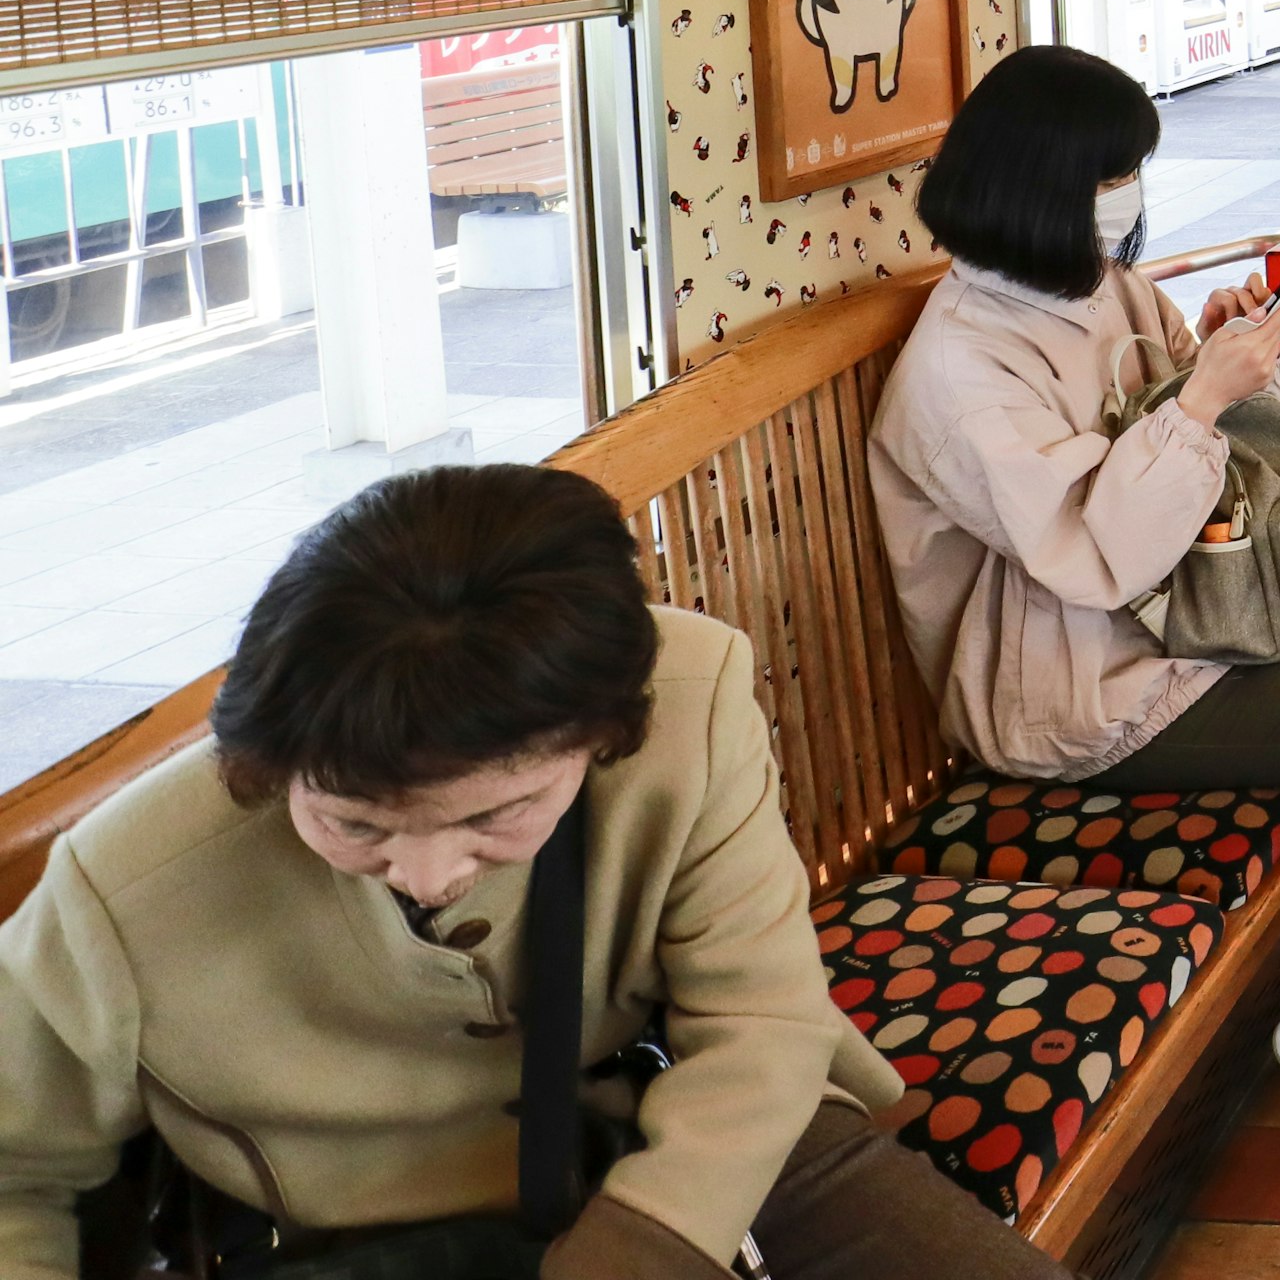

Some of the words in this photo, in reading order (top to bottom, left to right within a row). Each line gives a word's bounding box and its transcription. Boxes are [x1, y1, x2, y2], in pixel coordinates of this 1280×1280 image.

[1187, 28, 1231, 64] KIRIN
[145, 96, 191, 118] 86.1
[9, 116, 62, 139] 96.3
[852, 139, 874, 153] SUPER
[873, 133, 901, 147] STATION
[901, 126, 927, 140] MASTER
[1131, 912, 1145, 923] TA
[1123, 936, 1146, 948] MA
[841, 954, 872, 970] TAMA
[1041, 1041, 1066, 1051] MA
[1084, 1030, 1099, 1044] TA
[937, 1052, 968, 1081] TAMA
[946, 1151, 961, 1170] TA
[1000, 1185, 1015, 1211] MA
